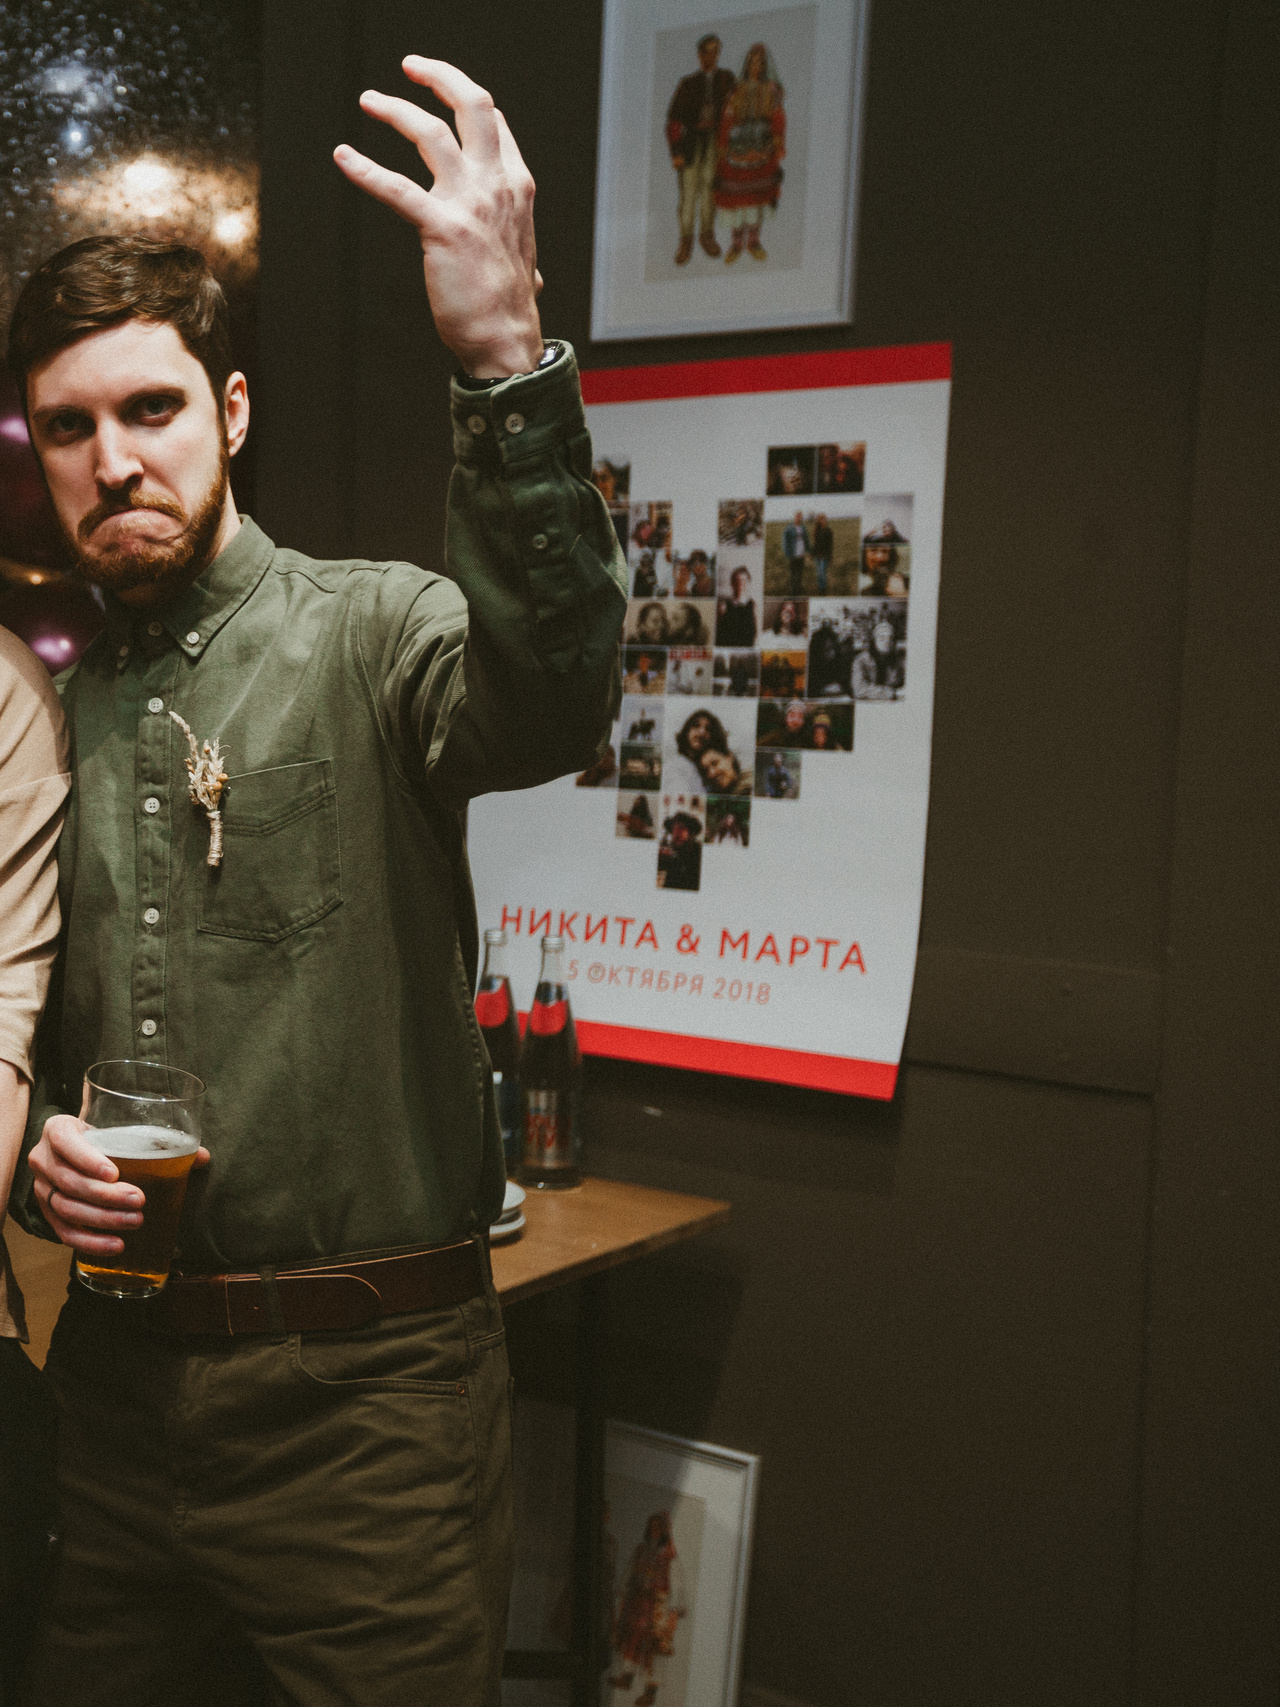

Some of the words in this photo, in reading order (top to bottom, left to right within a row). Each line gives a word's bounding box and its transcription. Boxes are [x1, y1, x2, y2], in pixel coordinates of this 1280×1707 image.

[501, 904, 660, 951] НИКИТА
[676, 923, 702, 955] &
[718, 928, 868, 974] МАРТА
[586, 961, 705, 997] ОКТЯБРЯ
[713, 977, 771, 1005] 2018
